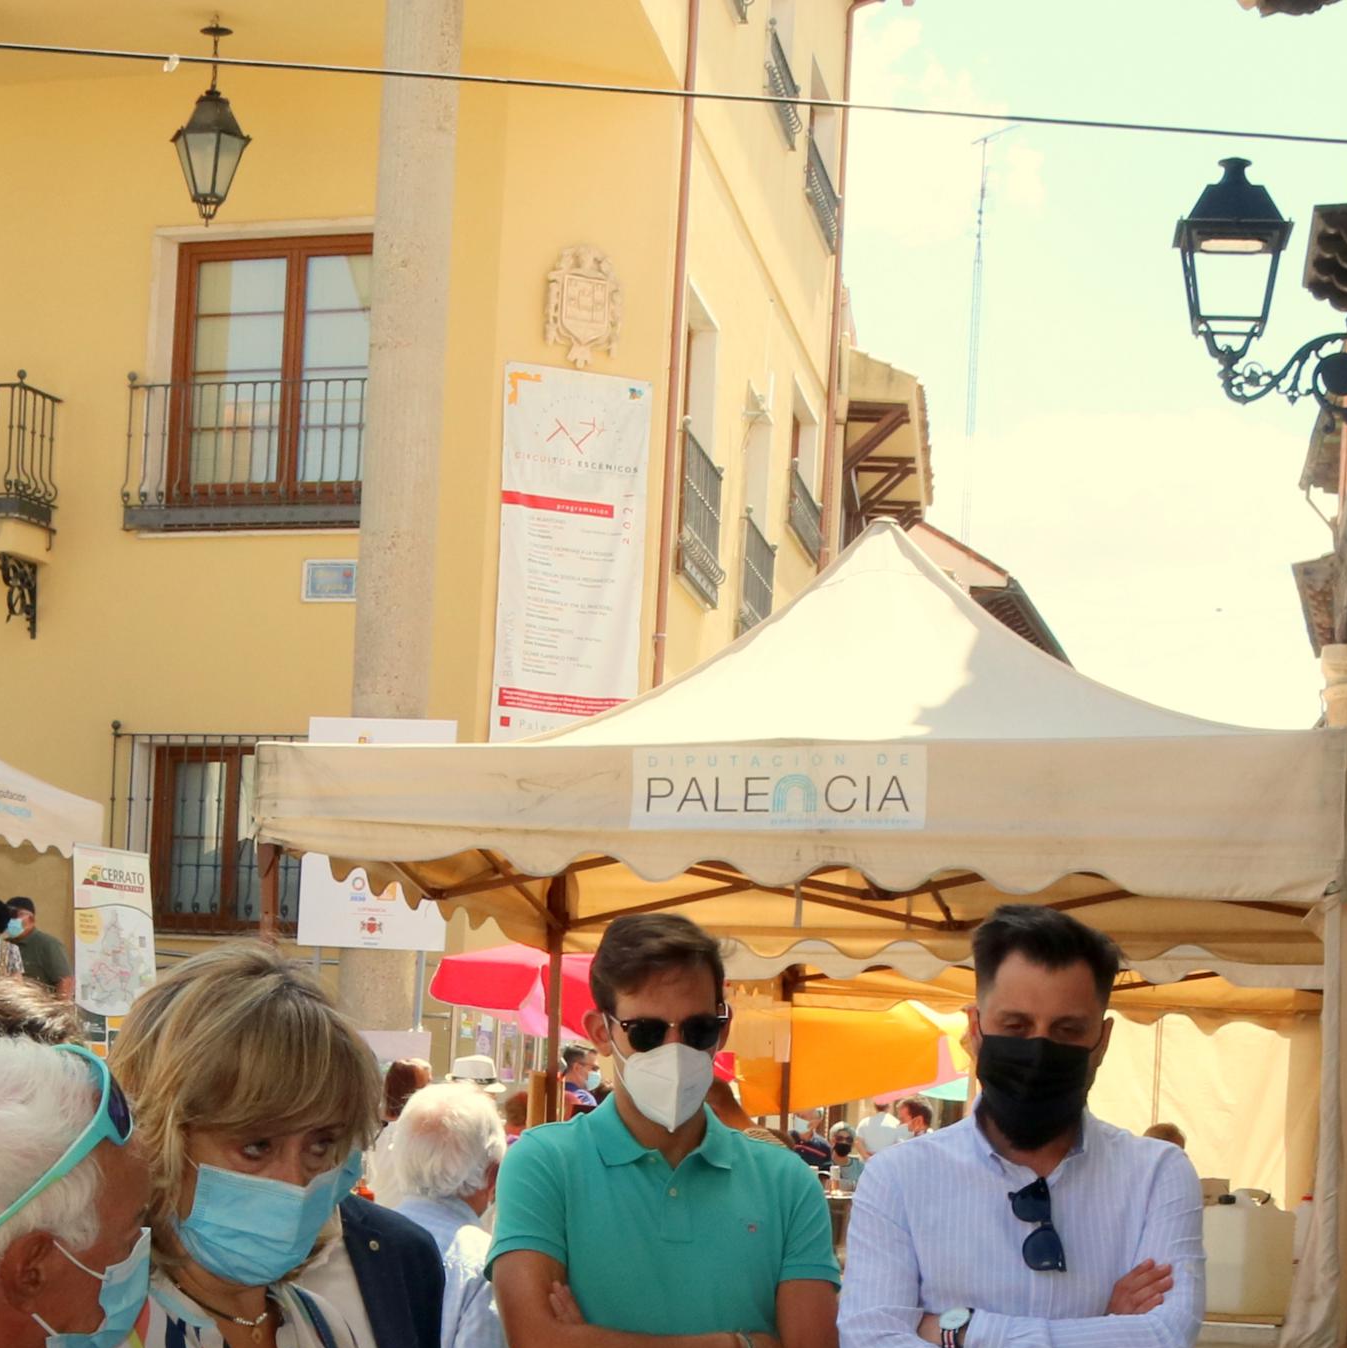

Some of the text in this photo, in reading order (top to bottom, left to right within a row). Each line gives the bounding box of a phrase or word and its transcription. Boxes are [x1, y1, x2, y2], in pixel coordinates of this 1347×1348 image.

[875, 753, 909, 766] DE
[645, 773, 910, 814] PALENCIA
[102, 866, 145, 886] CERRATO
